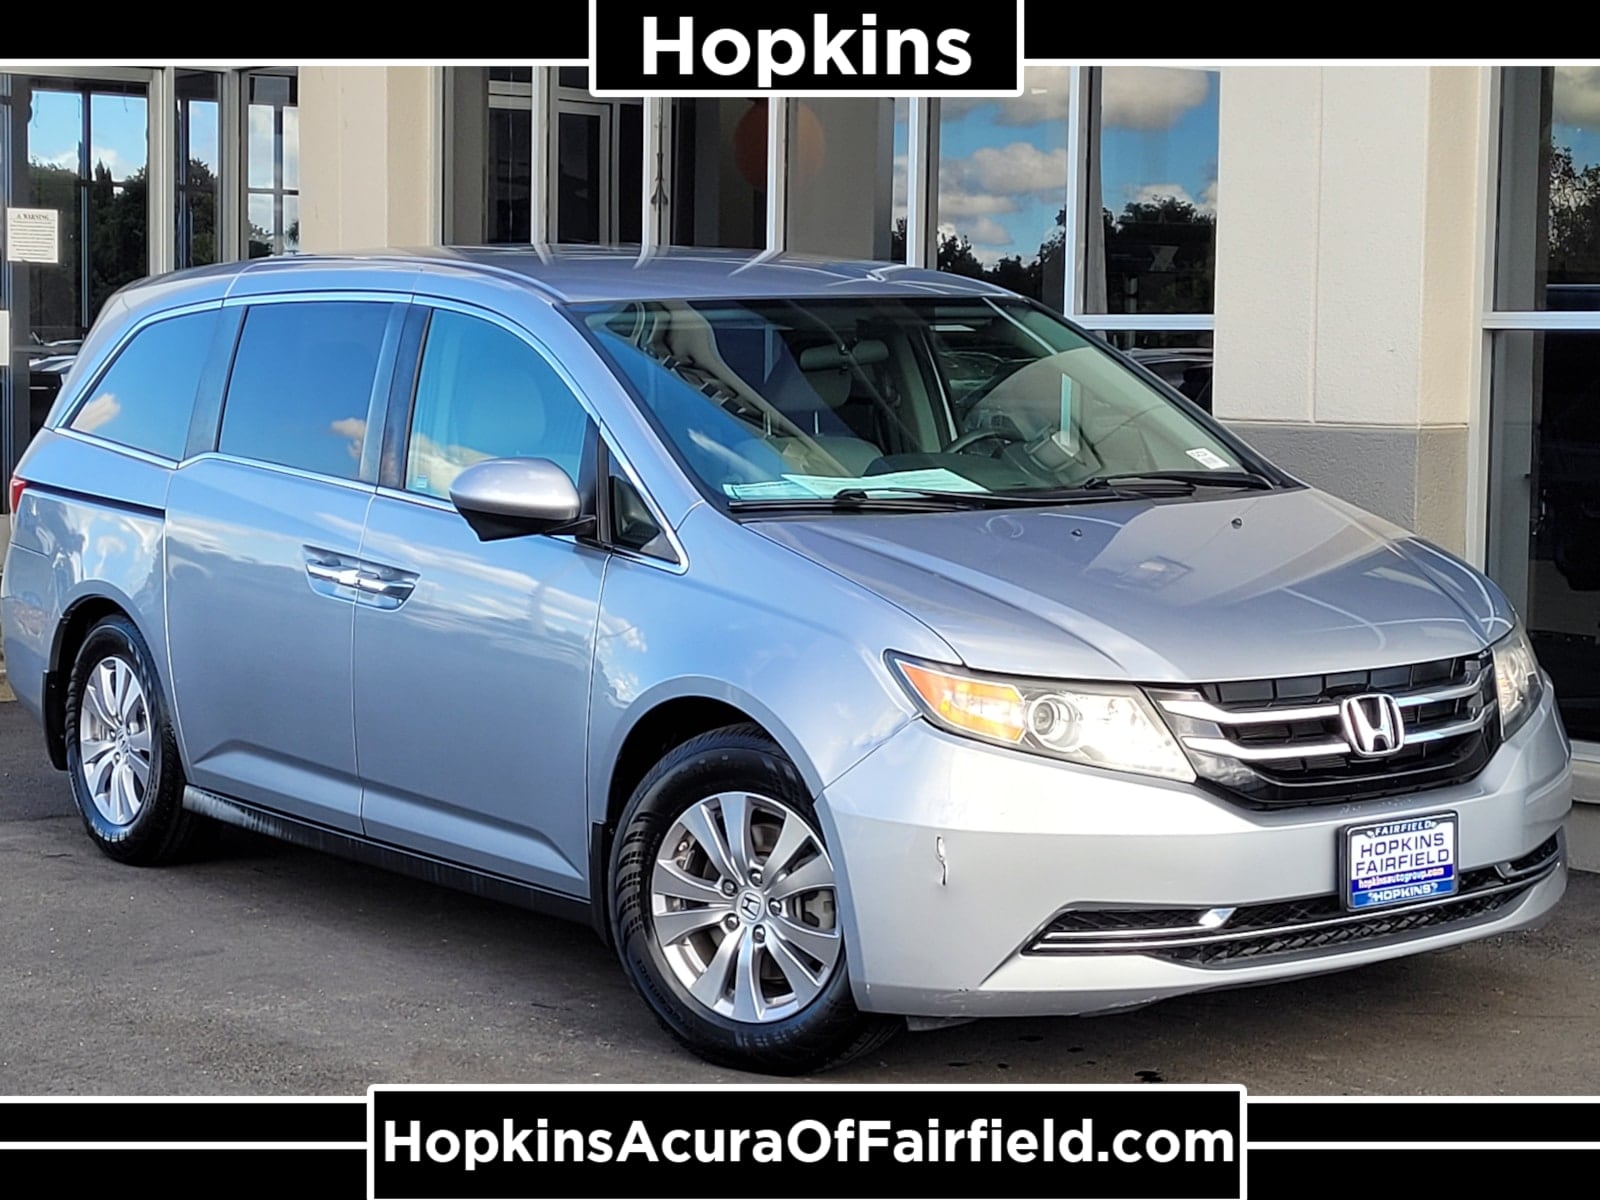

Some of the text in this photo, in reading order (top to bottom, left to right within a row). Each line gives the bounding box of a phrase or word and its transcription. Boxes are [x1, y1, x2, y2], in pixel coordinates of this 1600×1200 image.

[1375, 820, 1432, 836] FAIRFIELD
[1361, 832, 1444, 859] HOPKINS
[1356, 848, 1450, 877] FAIRFIELD
